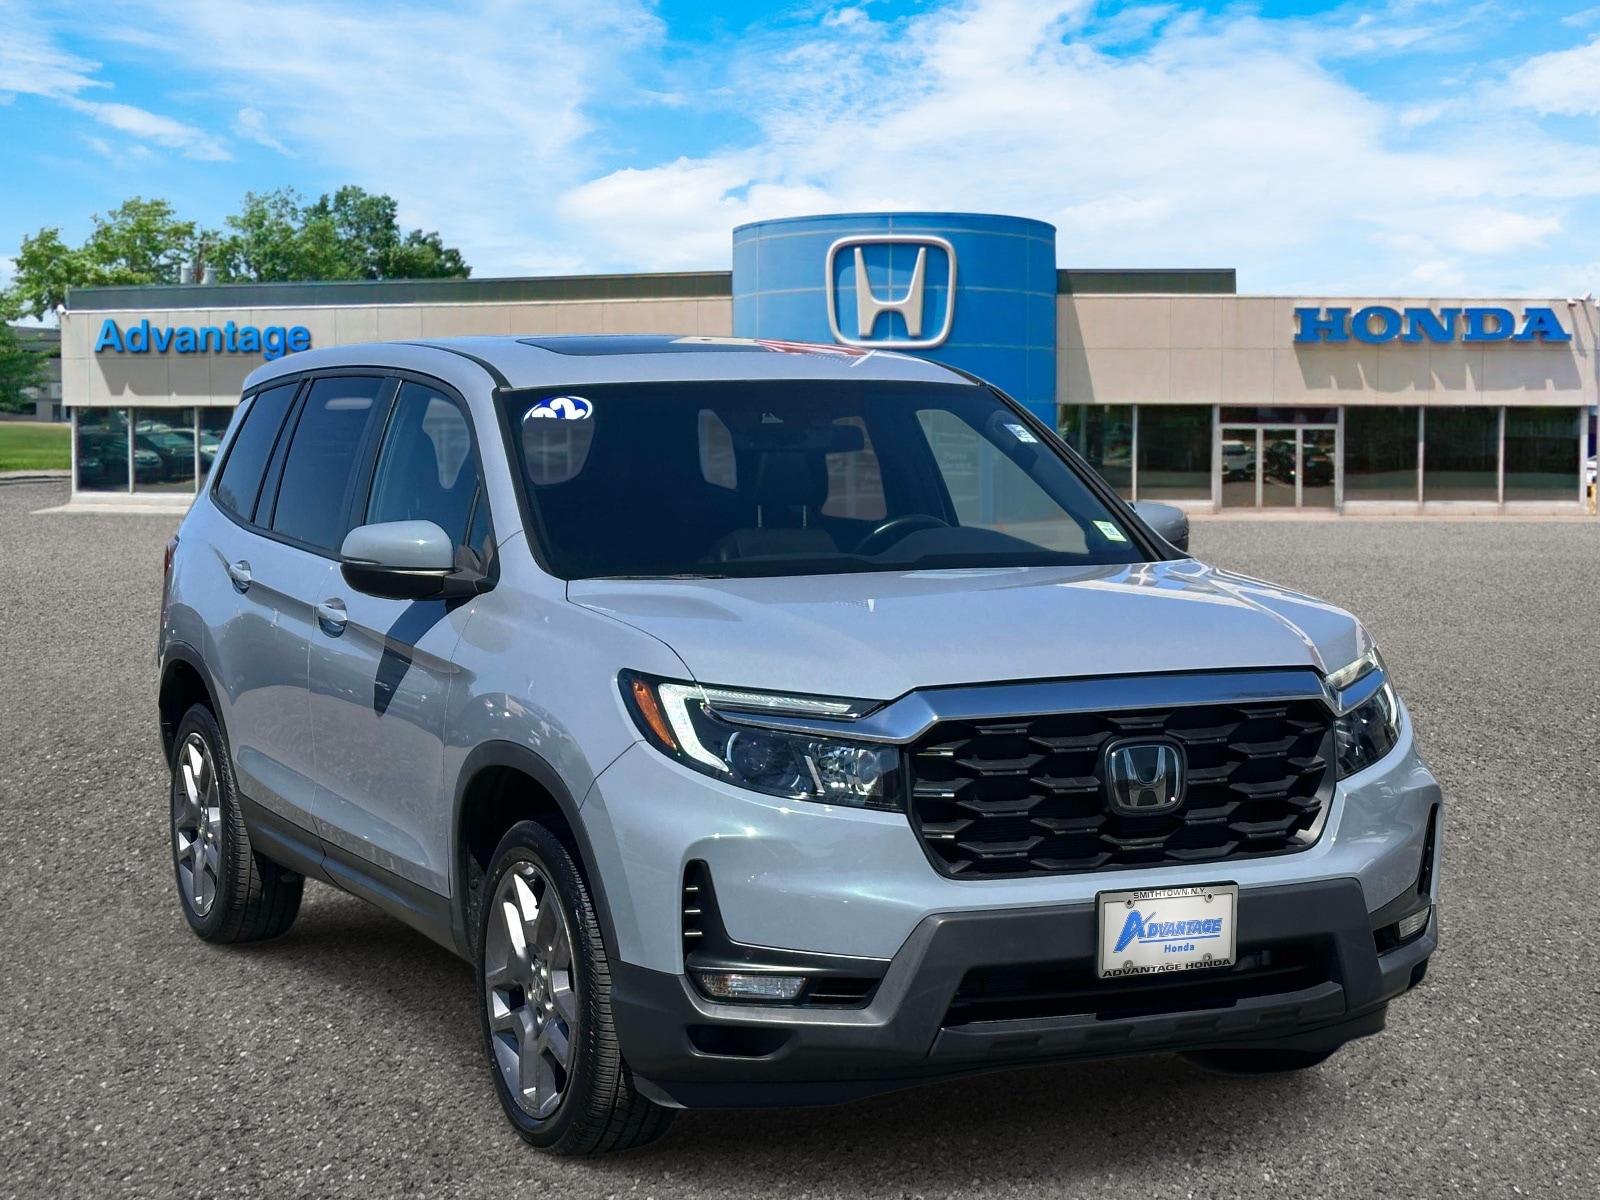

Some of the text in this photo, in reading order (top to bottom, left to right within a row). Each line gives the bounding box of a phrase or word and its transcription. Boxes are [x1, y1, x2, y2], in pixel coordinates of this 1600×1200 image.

[94, 318, 312, 361] Advantage
[1293, 306, 1573, 343] HONDA
[1113, 909, 1223, 954] ADVANTAGE
[1164, 943, 1195, 953] Honda
[1102, 959, 1232, 978] ADVANTAGE HONDA
